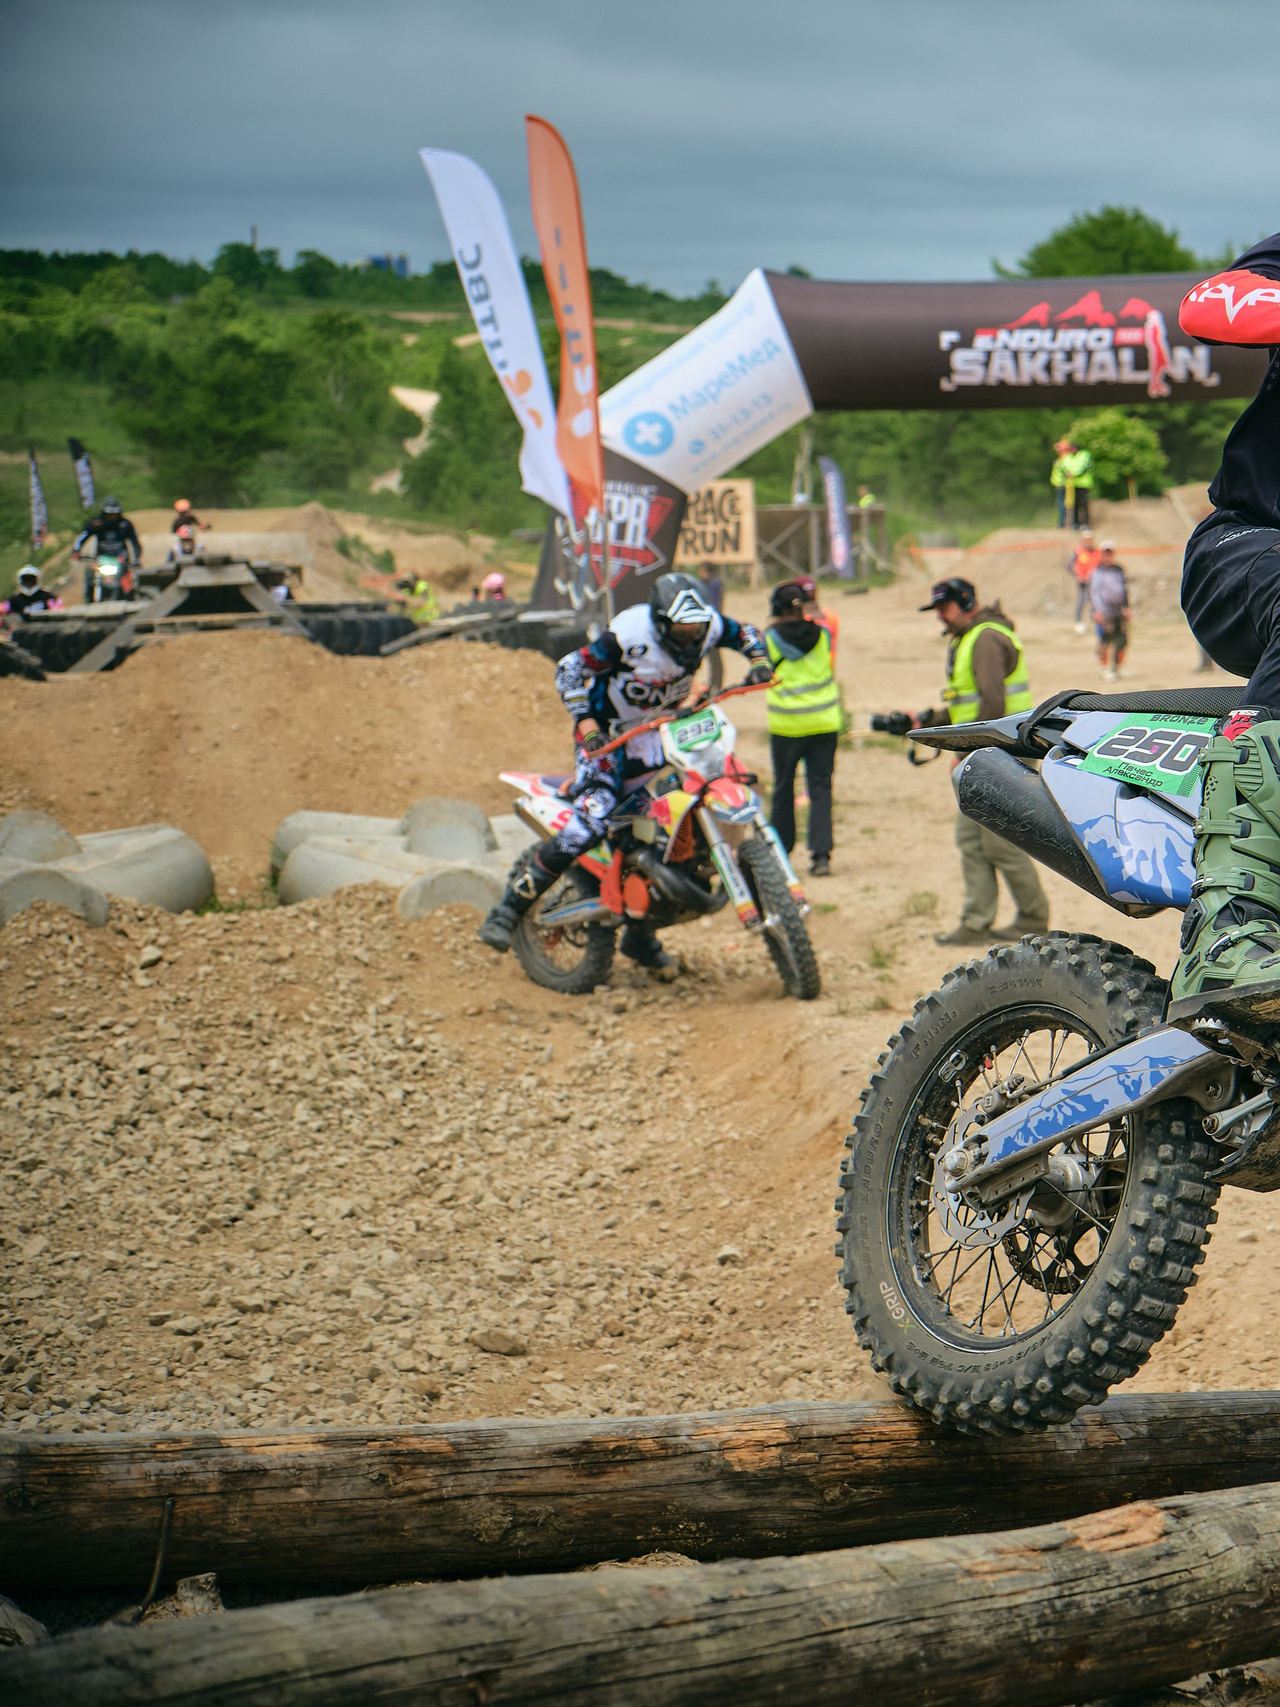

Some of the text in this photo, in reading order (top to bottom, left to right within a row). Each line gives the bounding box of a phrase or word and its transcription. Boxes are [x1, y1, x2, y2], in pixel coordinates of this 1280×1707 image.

[973, 328, 1114, 350] ENDURO
[950, 344, 1211, 387] SAKHALIN
[1093, 726, 1214, 776] 250
[1102, 766, 1164, 788] Александр
[879, 1281, 915, 1334] X-GRIP
